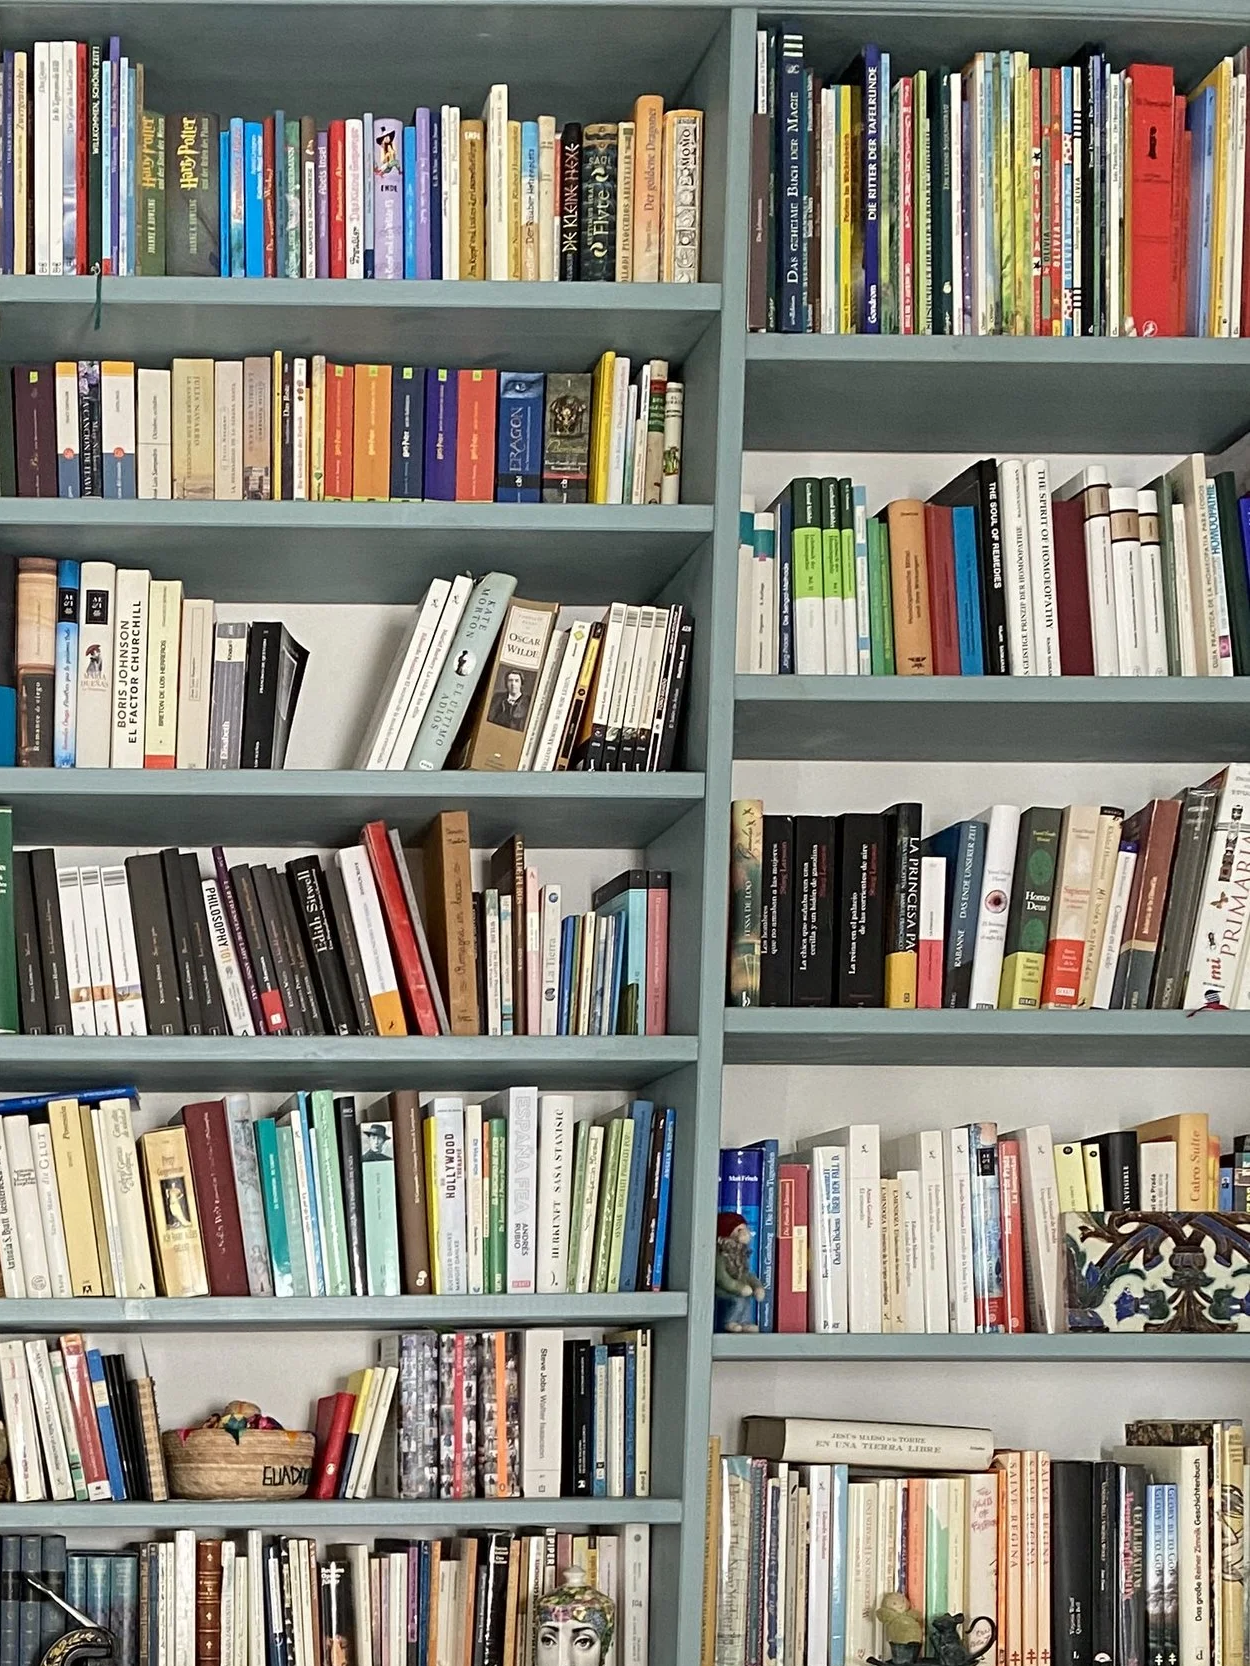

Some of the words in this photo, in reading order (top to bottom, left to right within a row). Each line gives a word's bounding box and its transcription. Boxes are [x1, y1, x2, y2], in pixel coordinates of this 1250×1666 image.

[868, 67, 877, 134] TAFELRUNDE
[141, 116, 155, 155] Potter
[180, 116, 198, 155] Potter
[681, 128, 691, 166] MOMO
[868, 139, 877, 160] DER
[141, 157, 157, 189] Harry
[180, 157, 199, 190] Harry
[562, 143, 578, 181] HEXE
[868, 163, 877, 199] RITTER
[562, 184, 578, 228] KLEINE
[592, 190, 612, 235] Flyte
[868, 202, 877, 220] DIE
[562, 233, 578, 252] DIE
[509, 407, 524, 471] ERAGON
[989, 482, 997, 499] THE
[1037, 469, 1046, 491] THE
[990, 502, 999, 526] SOUL
[1038, 493, 1048, 525] SPIRIT
[991, 528, 1000, 540] OF
[1041, 528, 1049, 540] OF
[992, 542, 1002, 588] REMEDIES
[466, 588, 492, 639] MORTON
[478, 600, 495, 631] KATE
[117, 621, 129, 686] JOHNSON
[130, 601, 141, 672] CHURCHILL
[507, 644, 539, 658] WILDE
[509, 633, 540, 646] OSCAR
[117, 690, 129, 728] BORIS
[129, 677, 139, 724] FACTOR
[128, 730, 137, 743] EL
[220, 721, 230, 759] Elisabeth
[907, 837, 918, 853] LA
[298, 870, 316, 913] Sitwell
[907, 858, 918, 928] PRINCESA
[1025, 892, 1049, 901] Homo
[1026, 902, 1047, 911] Deus
[206, 887, 225, 947] PHILOSOPHY
[310, 916, 328, 952] Edith
[954, 930, 965, 967] RABANNE
[1209, 957, 1222, 980] mi
[38, 1132, 49, 1170] GLUT
[445, 1133, 456, 1199] HOLLYWOOD
[514, 1178, 529, 1215] FEA
[1190, 1166, 1200, 1201] Cairo
[513, 1222, 522, 1249] RUBIO
[522, 1222, 530, 1256] ANDRÉS
[539, 1347, 547, 1371] Steve
[1010, 1461, 1018, 1504] SALVE
[1193, 1459, 1201, 1526] Geschichtenbuch
[546, 1537, 554, 1565] PIPER
[1010, 1514, 1018, 1567] REGINA
[1193, 1528, 1201, 1553] Zimnik
[1194, 1582, 1203, 1605] große
